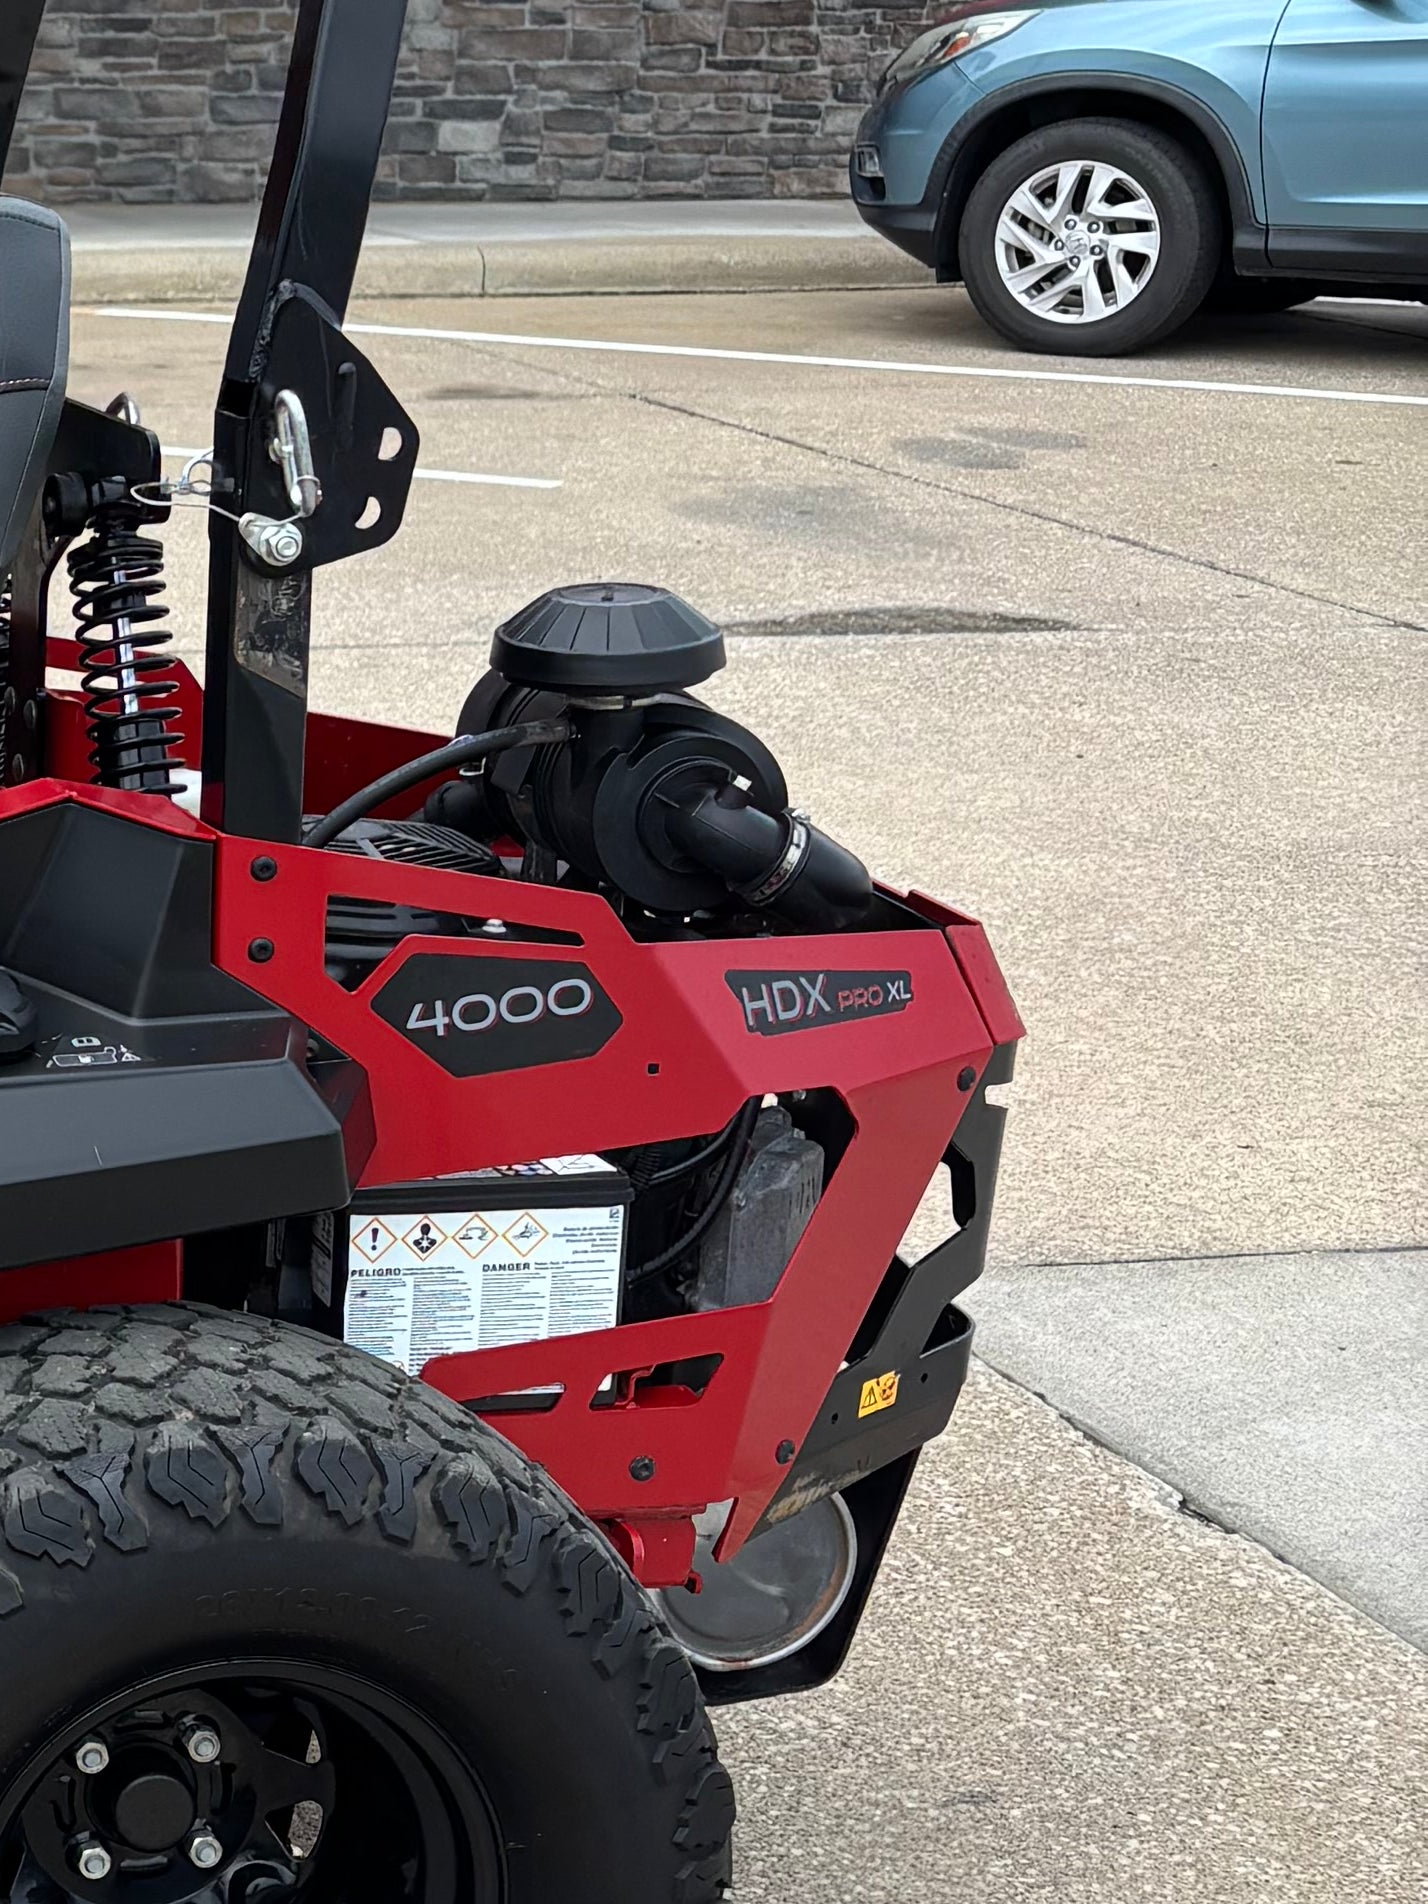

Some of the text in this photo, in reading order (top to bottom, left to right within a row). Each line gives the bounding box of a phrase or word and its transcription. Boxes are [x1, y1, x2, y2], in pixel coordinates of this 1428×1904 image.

[406, 978, 592, 1037] 4000
[742, 973, 912, 1027] HDX PRO XL
[350, 1267, 402, 1278] PELIGRO
[482, 1262, 531, 1273] DANGER
